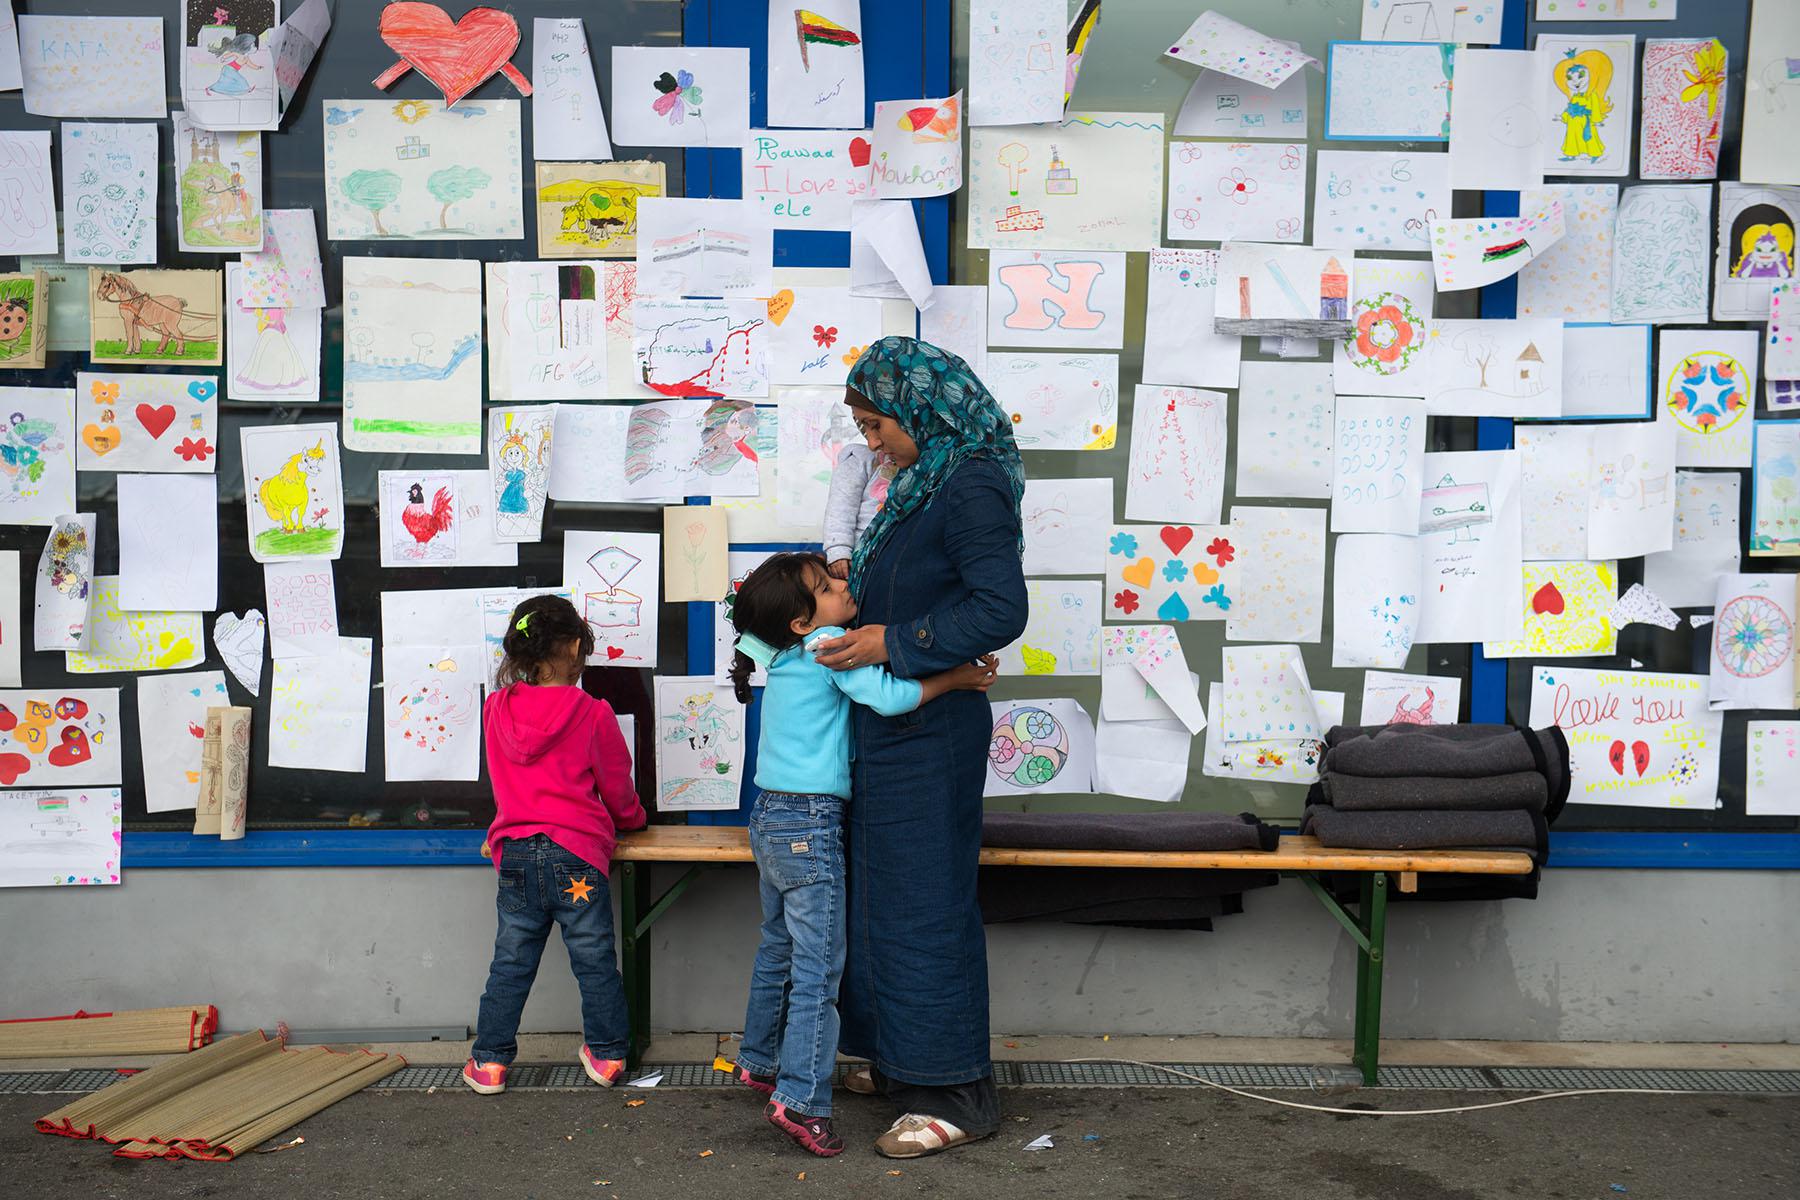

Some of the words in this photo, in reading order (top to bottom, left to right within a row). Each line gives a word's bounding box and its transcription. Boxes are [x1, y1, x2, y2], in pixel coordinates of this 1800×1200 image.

[41, 39, 110, 62] KAFA
[755, 166, 779, 193] I
[786, 168, 836, 195] Love
[846, 176, 866, 195] yo
